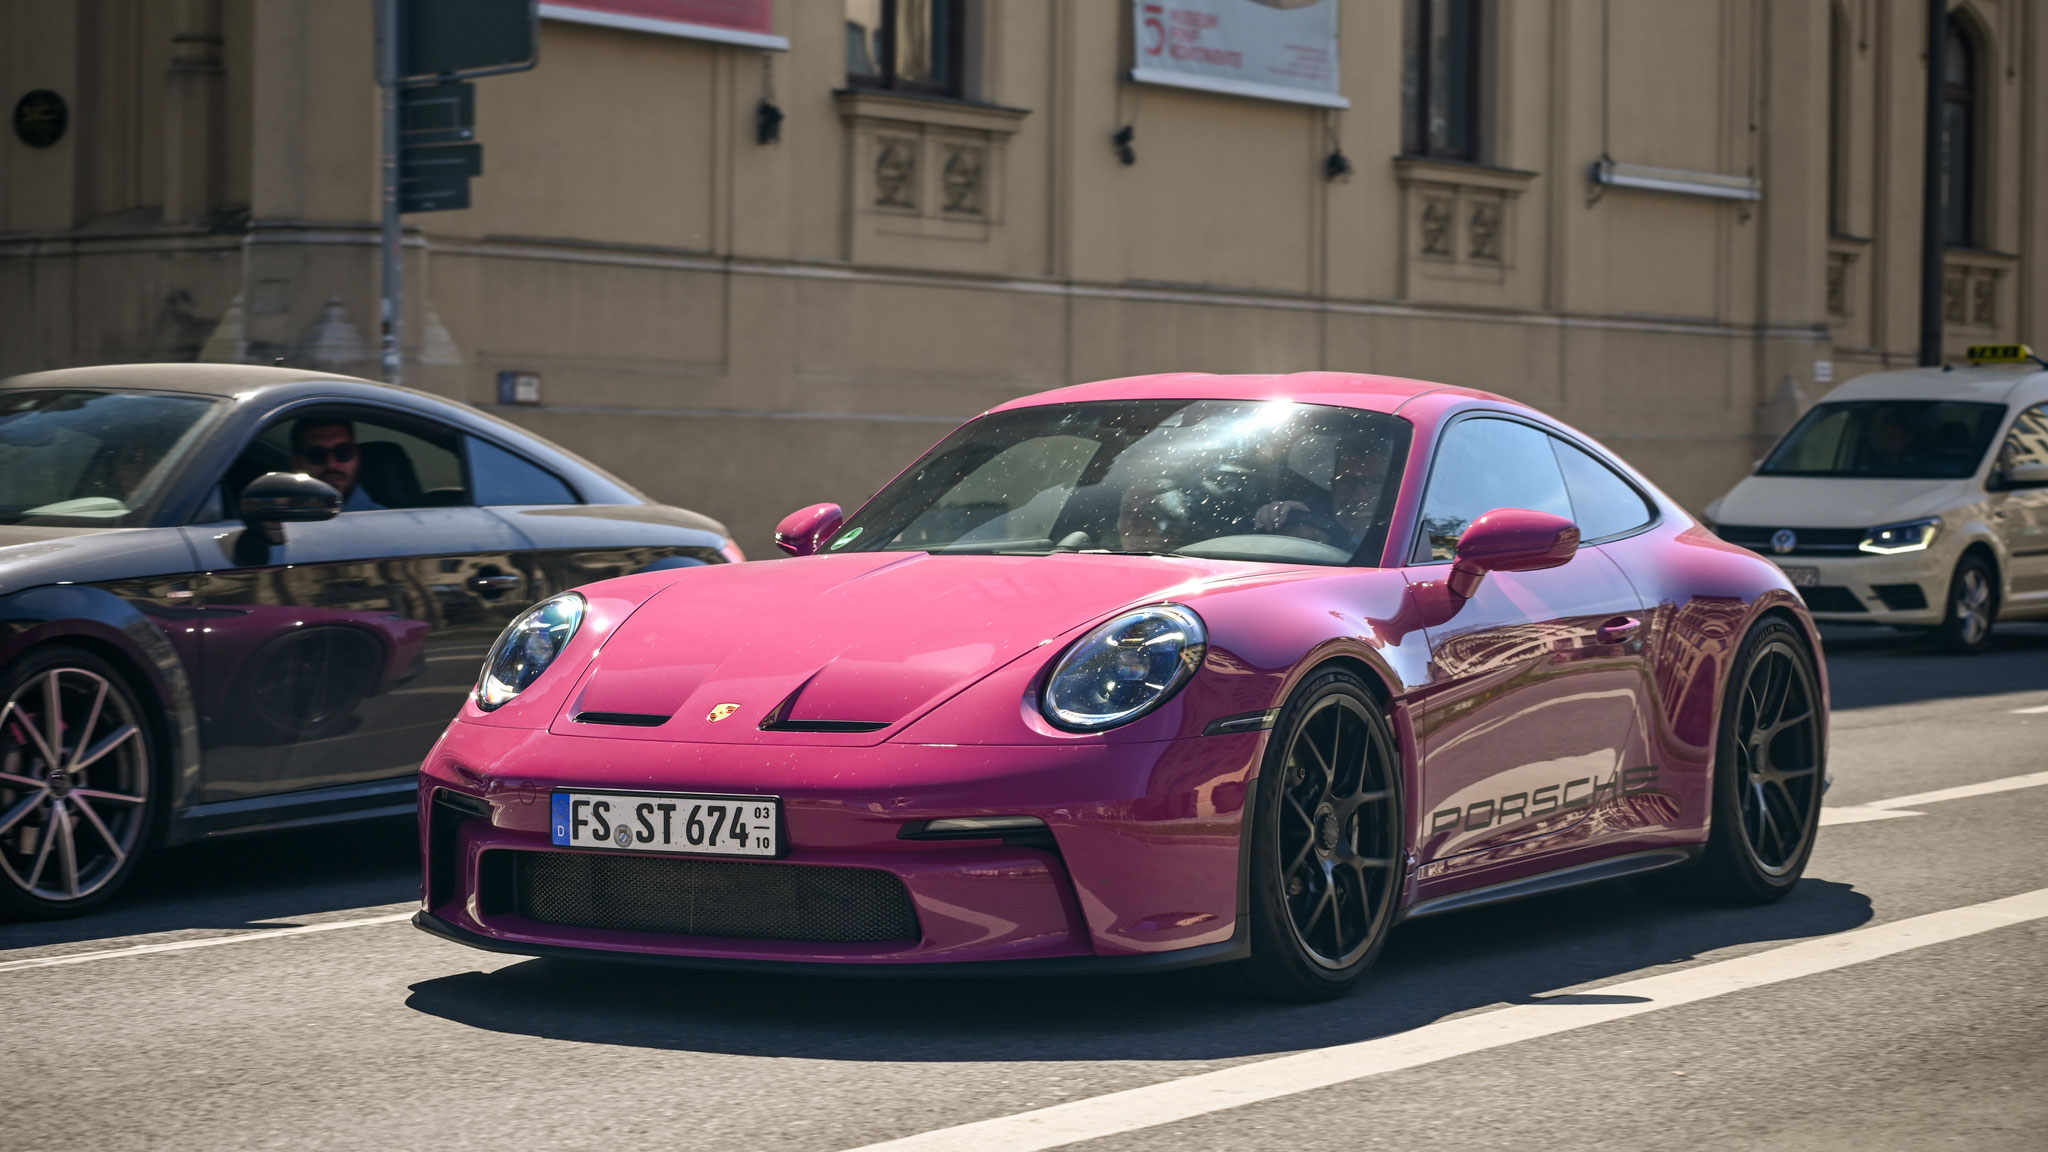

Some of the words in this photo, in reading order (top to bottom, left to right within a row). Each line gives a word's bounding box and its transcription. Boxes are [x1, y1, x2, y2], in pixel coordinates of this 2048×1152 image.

[754, 807, 770, 819] 03
[1431, 766, 1659, 836] PORSCHE
[557, 825, 565, 837] D
[572, 800, 611, 841] FS
[635, 803, 677, 844] ST
[686, 805, 749, 848] 674
[756, 836, 770, 849] 10
